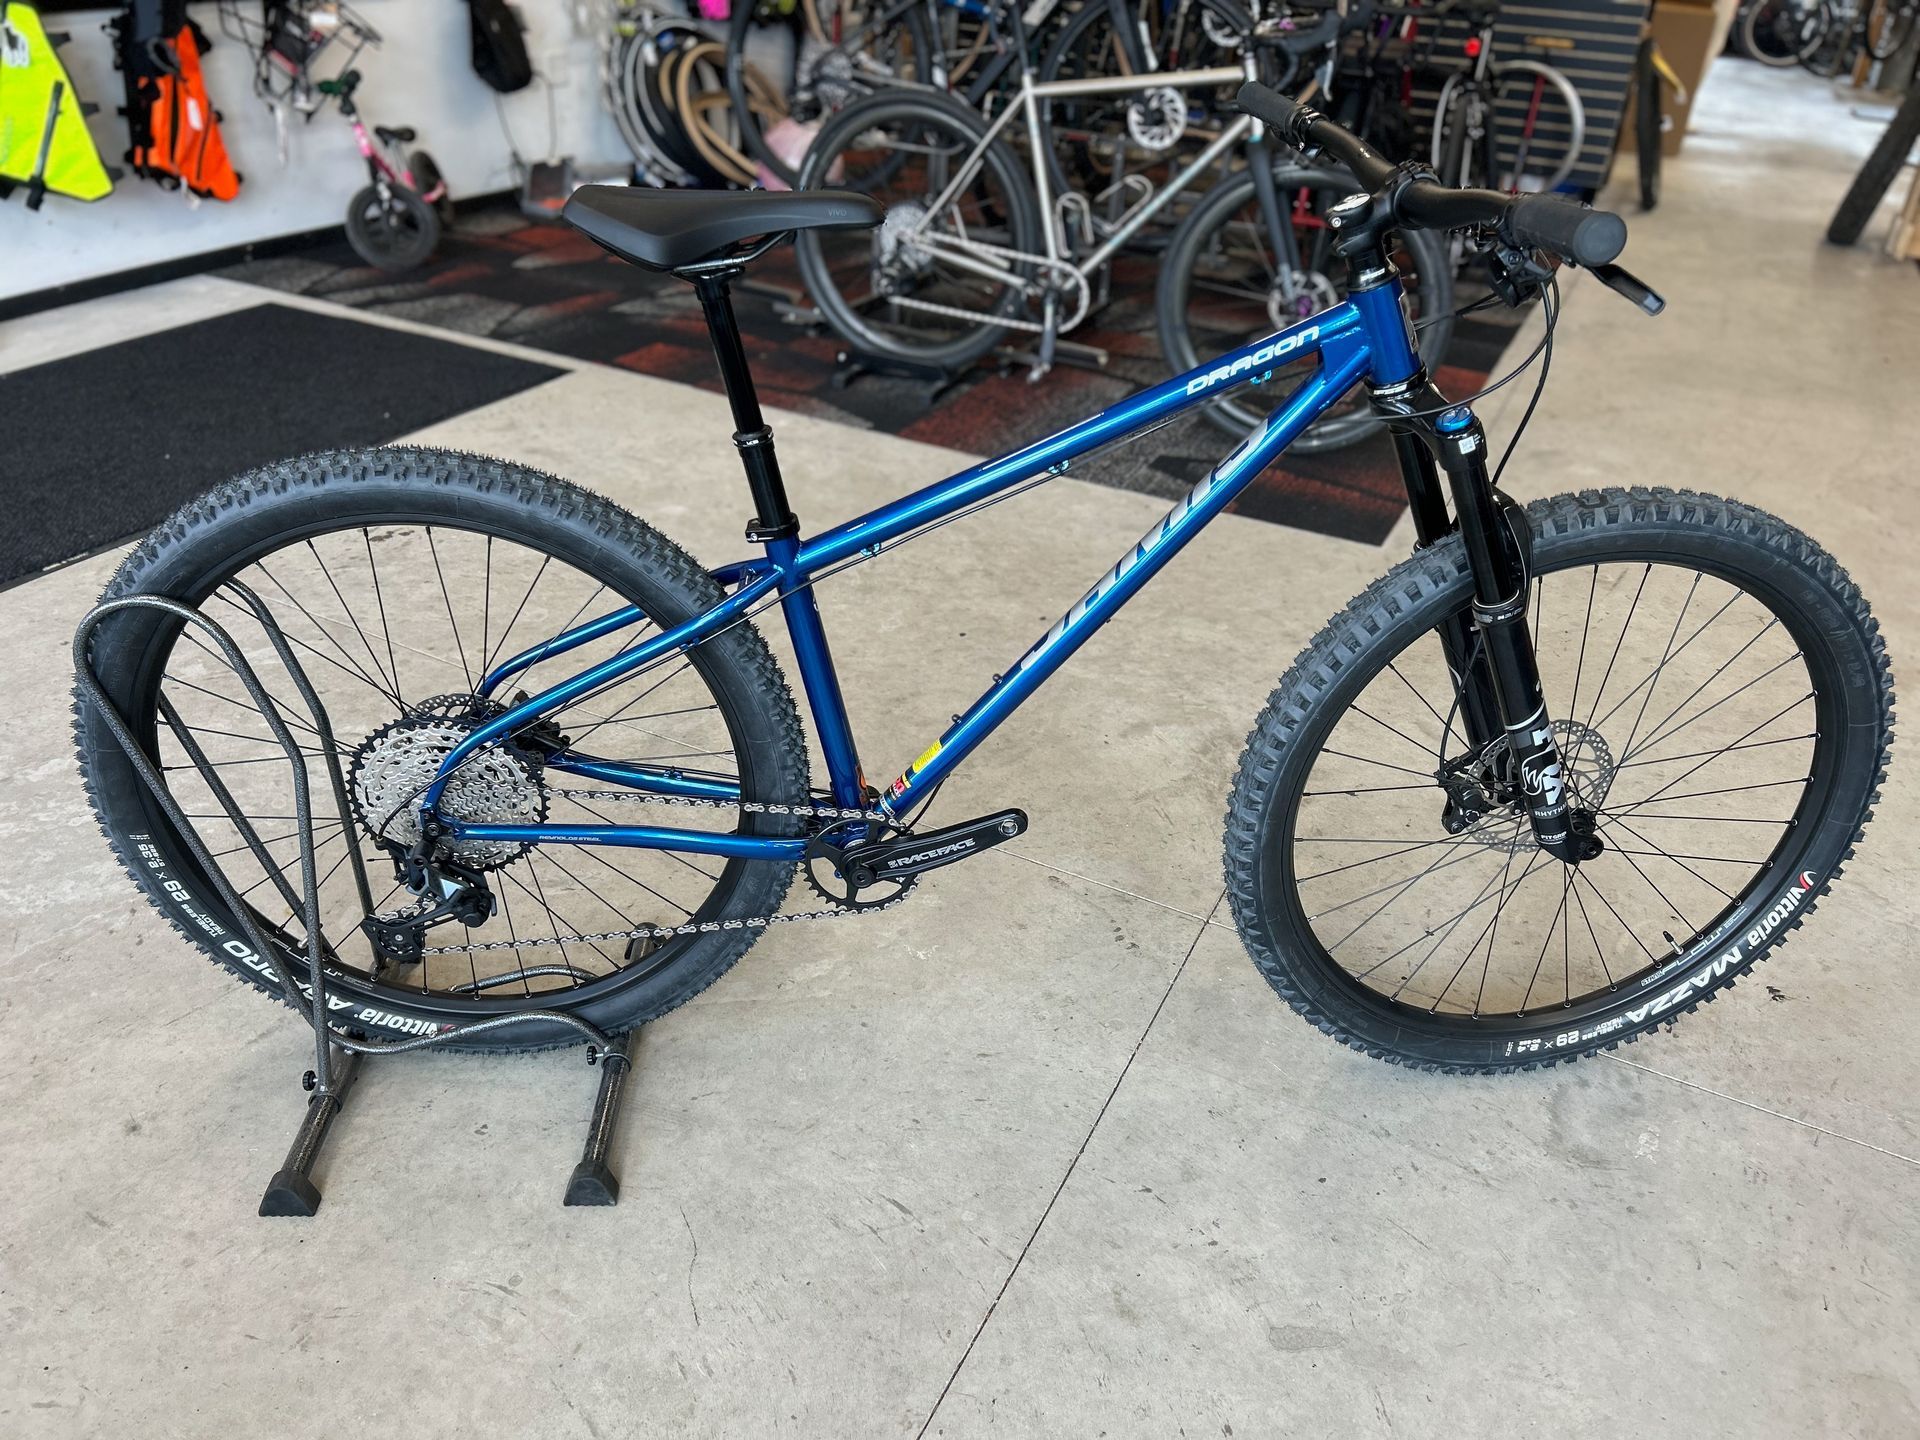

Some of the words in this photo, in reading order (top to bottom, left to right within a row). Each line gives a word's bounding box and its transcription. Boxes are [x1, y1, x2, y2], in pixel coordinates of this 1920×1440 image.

[1187, 326, 1320, 396] DRAGON
[163, 880, 191, 902] 29
[1625, 945, 1743, 1024] MAZZA
[1556, 1030, 1580, 1048] 29
